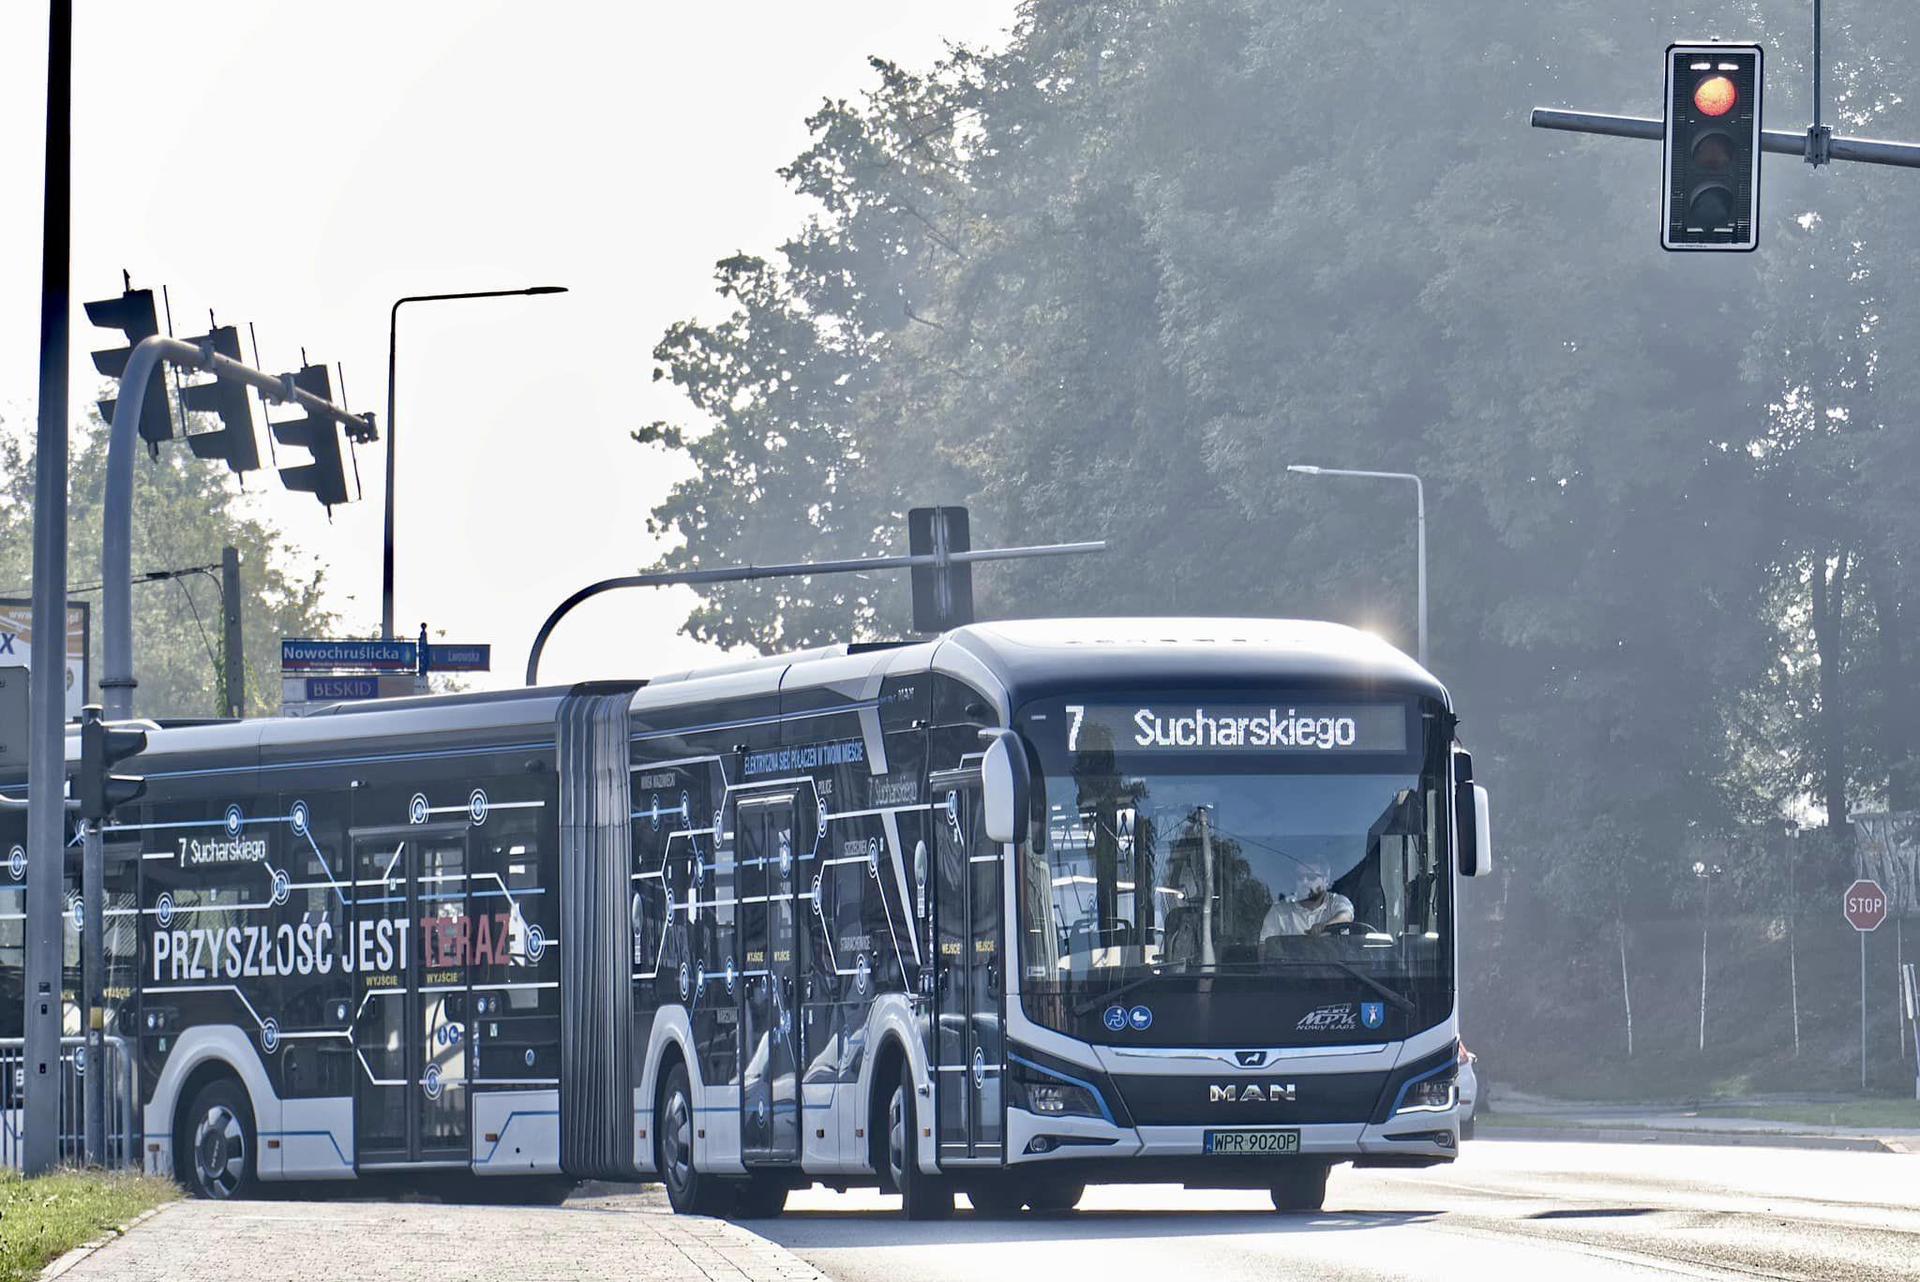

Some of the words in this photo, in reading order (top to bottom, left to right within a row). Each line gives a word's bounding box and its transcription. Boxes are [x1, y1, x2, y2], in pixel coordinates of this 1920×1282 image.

[283, 645, 399, 661] Nowochruślicka
[313, 681, 371, 697] BESKID
[1065, 705, 1085, 752] 7
[1133, 708, 1357, 750] Sucharskiego
[178, 838, 187, 868] 7
[190, 835, 266, 864] Sucharskiego
[1849, 897, 1882, 913] STOP
[154, 911, 333, 981] PRZYSZŁOŚĆ
[341, 918, 410, 973] JEST
[420, 913, 510, 968] TERAZ
[366, 974, 398, 987] WYJŚCIE
[426, 972, 458, 985] WYJŚCIE
[1209, 1084, 1296, 1102] MAN
[1214, 1134, 1244, 1151] WPR
[1249, 1134, 1296, 1151] 9020P
